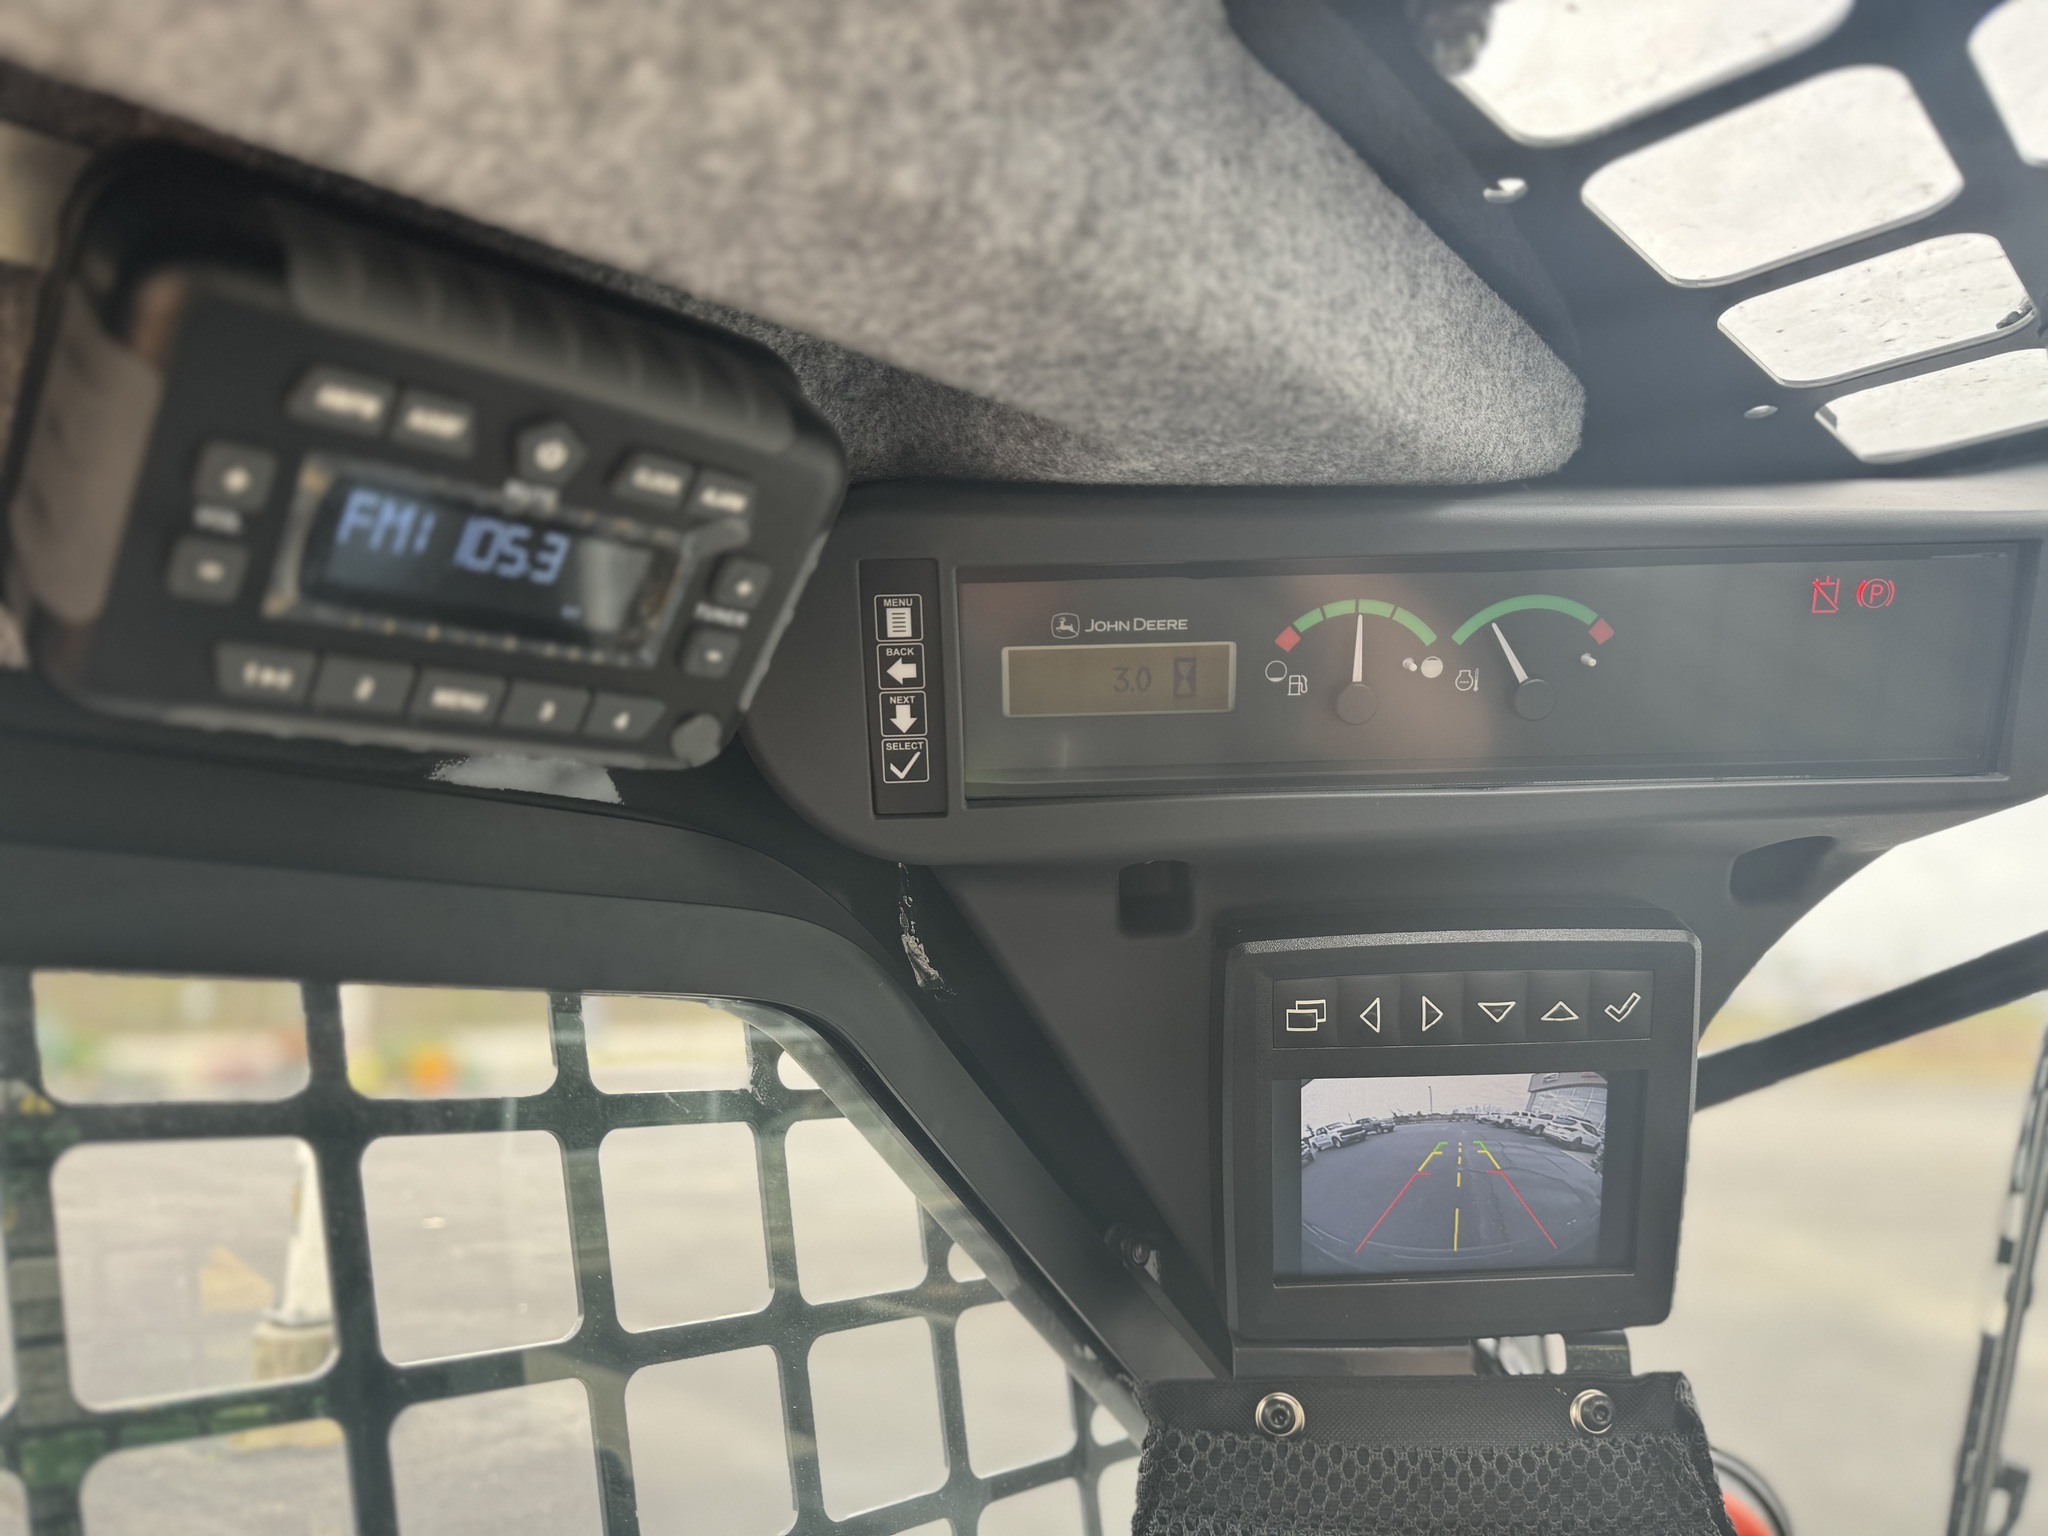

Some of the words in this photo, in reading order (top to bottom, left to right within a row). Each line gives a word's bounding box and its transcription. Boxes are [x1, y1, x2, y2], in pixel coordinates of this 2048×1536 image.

[883, 598, 914, 608] MENU
[1085, 618, 1130, 633] JOHN
[1133, 617, 1189, 631] DEERE
[886, 647, 915, 657] BACK
[1113, 666, 1153, 693] 3.0
[889, 695, 916, 705] NEXT
[885, 741, 925, 751] SELECT
